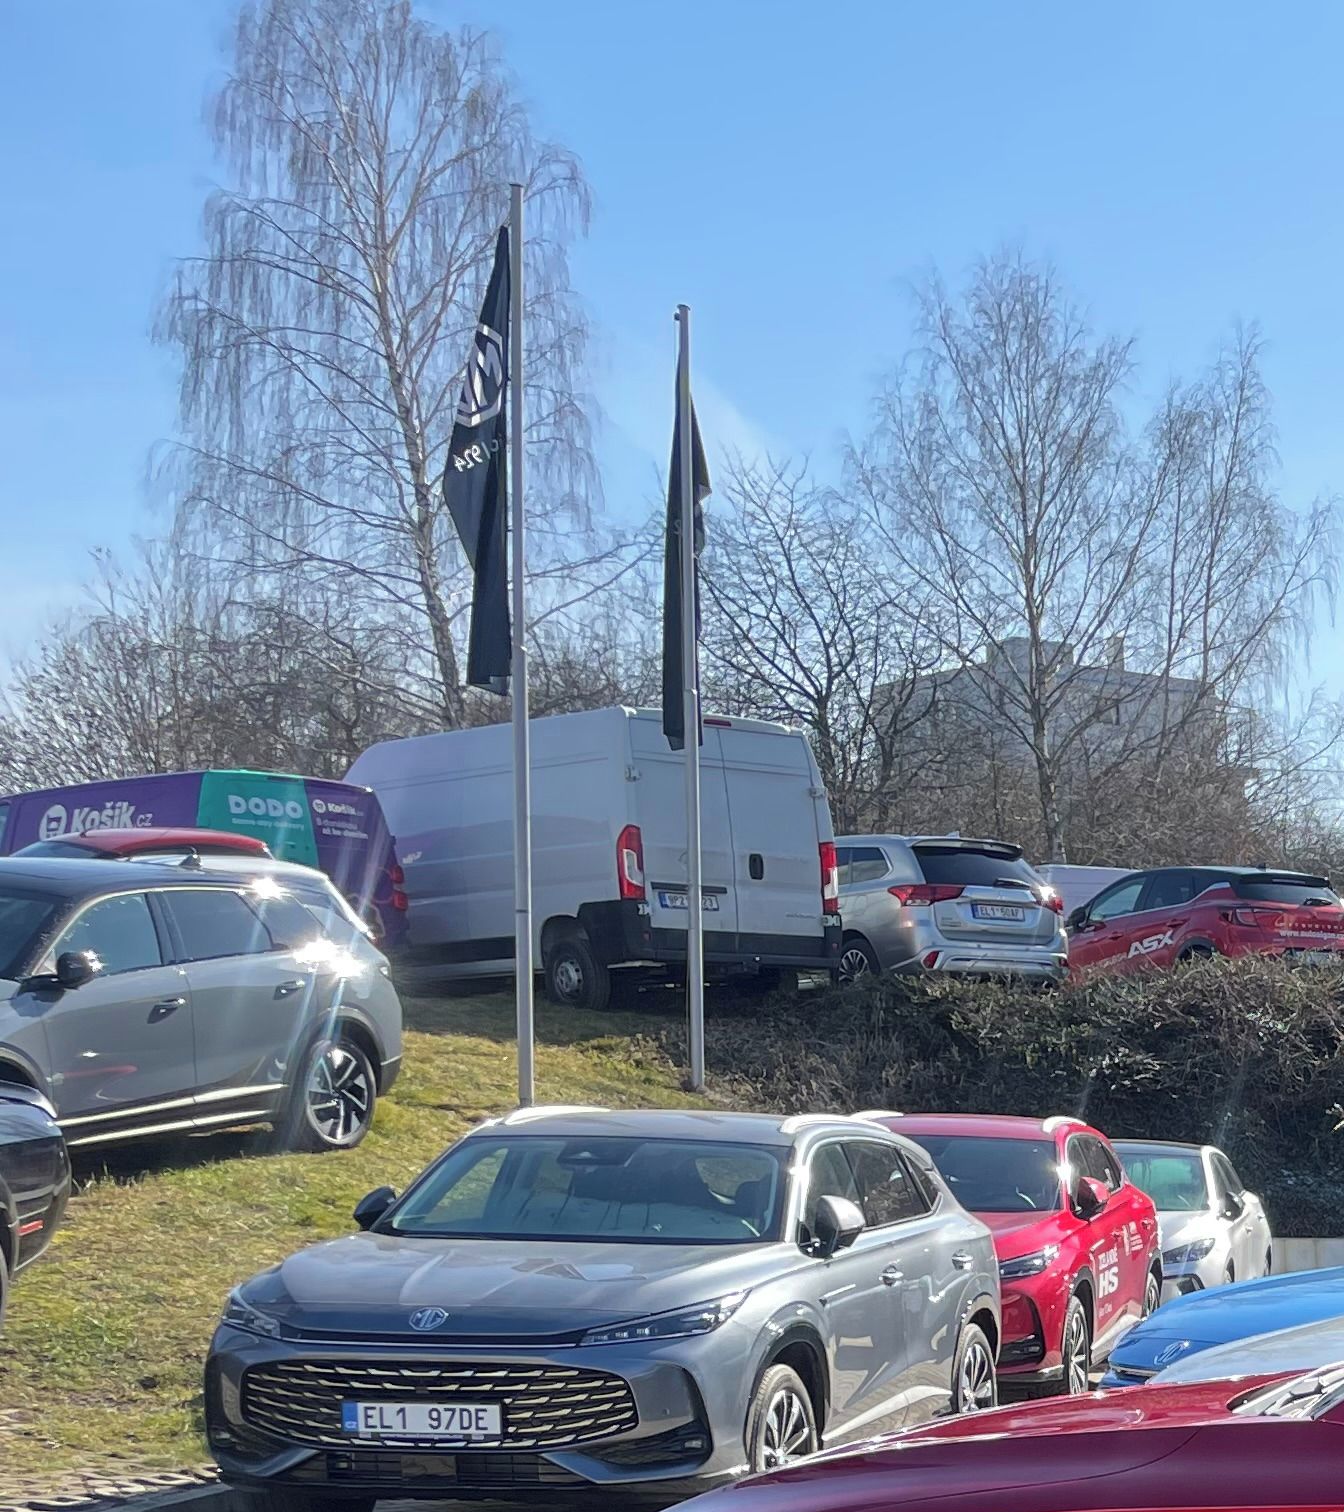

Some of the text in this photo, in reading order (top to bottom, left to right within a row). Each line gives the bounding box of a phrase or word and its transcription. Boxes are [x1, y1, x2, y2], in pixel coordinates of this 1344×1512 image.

[228, 795, 303, 819] DODO
[1127, 929, 1174, 959] ASX
[1098, 1266, 1119, 1299] HS
[411, 1308, 445, 1329] MG
[363, 1406, 407, 1430] EL1
[428, 1407, 488, 1431] 97DE
